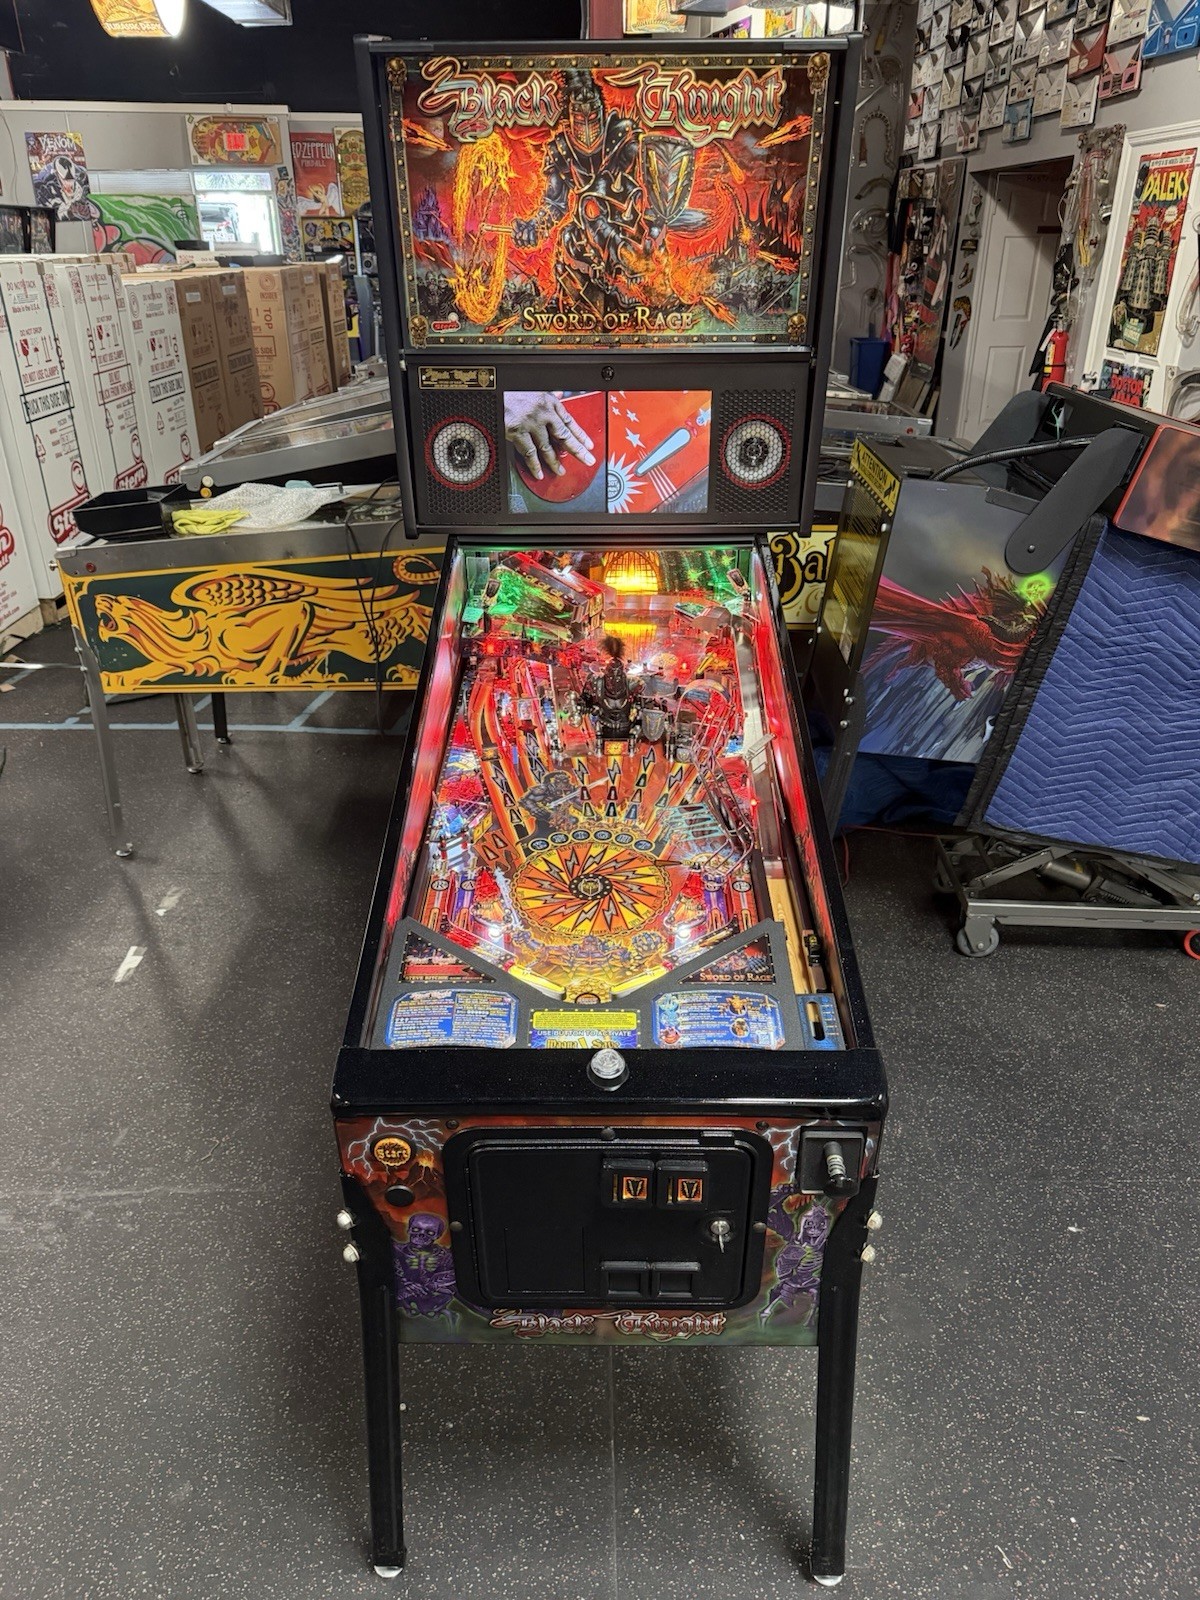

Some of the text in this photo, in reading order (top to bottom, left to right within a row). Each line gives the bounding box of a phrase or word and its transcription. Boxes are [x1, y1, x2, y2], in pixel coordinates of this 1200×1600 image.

[420, 56, 788, 148] Black Knight
[39, 134, 77, 154] VENOM
[1140, 170, 1189, 202] DALEKS
[770, 533, 837, 606] Bal
[489, 1308, 728, 1342] Black Knight
